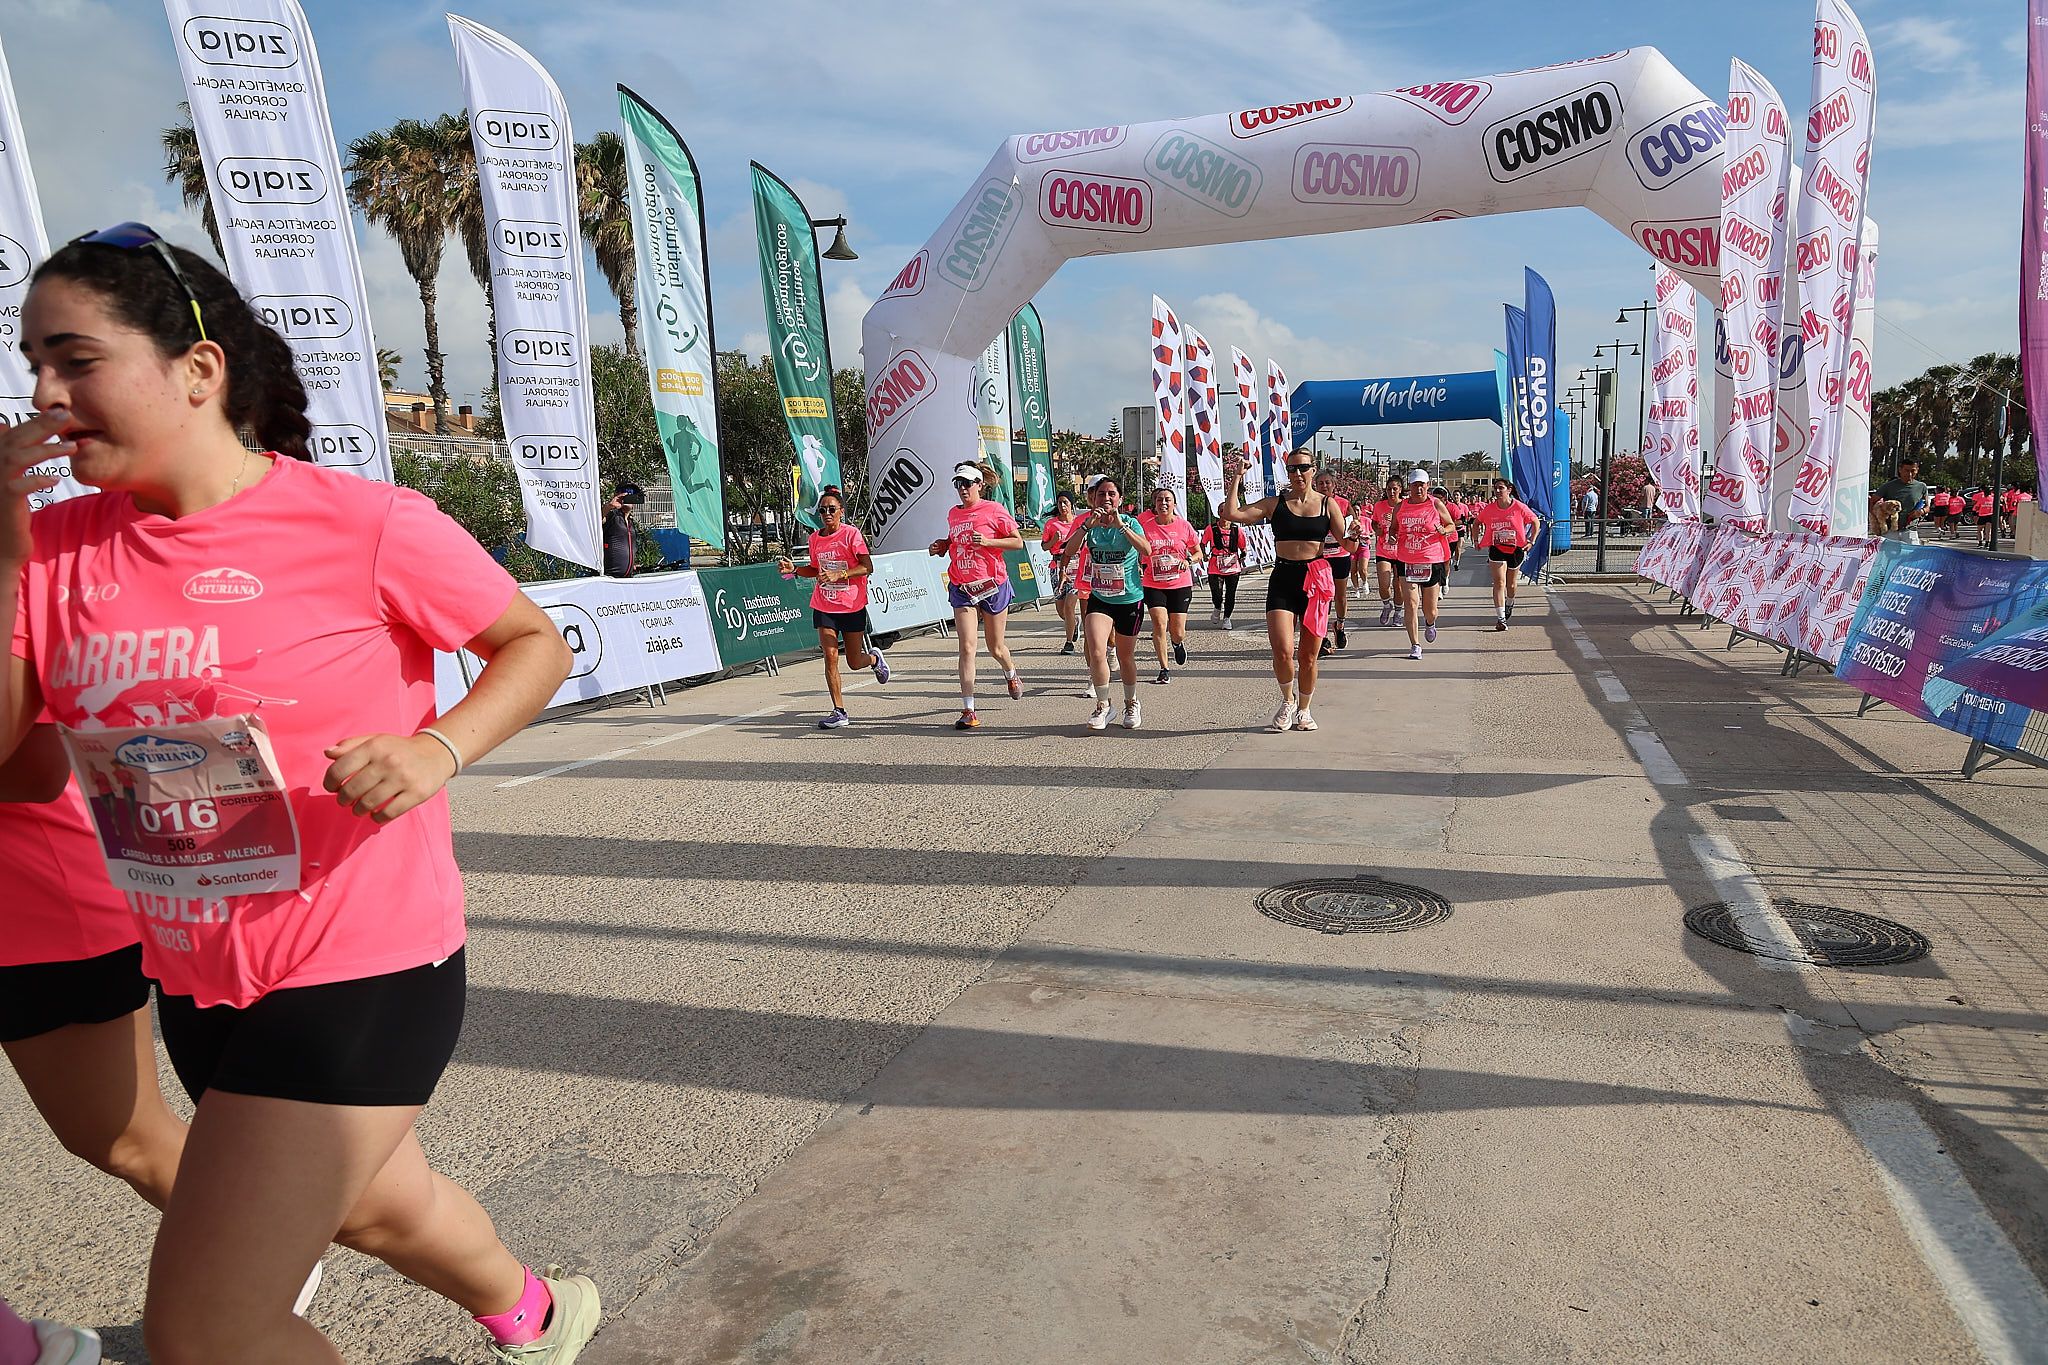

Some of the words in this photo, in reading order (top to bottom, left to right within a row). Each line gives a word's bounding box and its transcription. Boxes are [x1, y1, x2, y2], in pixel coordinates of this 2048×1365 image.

[1025, 127, 1119, 156] COSMO
[1495, 91, 1611, 172] COSMO
[1639, 105, 1729, 178] COSM
[1155, 136, 1253, 210] COSMO
[1303, 151, 1409, 198] COSMO
[1048, 177, 1144, 226] COSMO
[945, 185, 1014, 283] COSMO
[1641, 225, 1721, 268] COSM
[1361, 381, 1447, 417] Marlene
[189, 583, 256, 596] ASTURIANA
[886, 577, 913, 588] Institutos
[743, 595, 781, 611] Institutos
[889, 585, 928, 602] Odontológicos
[596, 600, 641, 619] COSMÉTICA
[642, 599, 665, 614] FACIAL,
[666, 597, 701, 610] CORPORAL
[1897, 596, 1913, 615] EL
[640, 618, 646, 629] Y
[646, 617, 674, 628] CAPILAR
[748, 608, 802, 627] Odontológicos
[1881, 621, 1901, 642] DE
[645, 635, 684, 654] ziaja.es
[51, 625, 222, 689] CARRERA
[220, 792, 281, 807] CORREDORA
[139, 798, 219, 834] 016
[121, 847, 151, 863] CARRERA
[152, 854, 164, 863] DE
[165, 855, 178, 865] LA
[179, 852, 215, 864] MUJER
[224, 845, 276, 860] VALENCIA
[167, 837, 197, 852] 508
[127, 867, 175, 887] OYSHO
[213, 869, 279, 886] Santander
[151, 923, 193, 953] 2026
